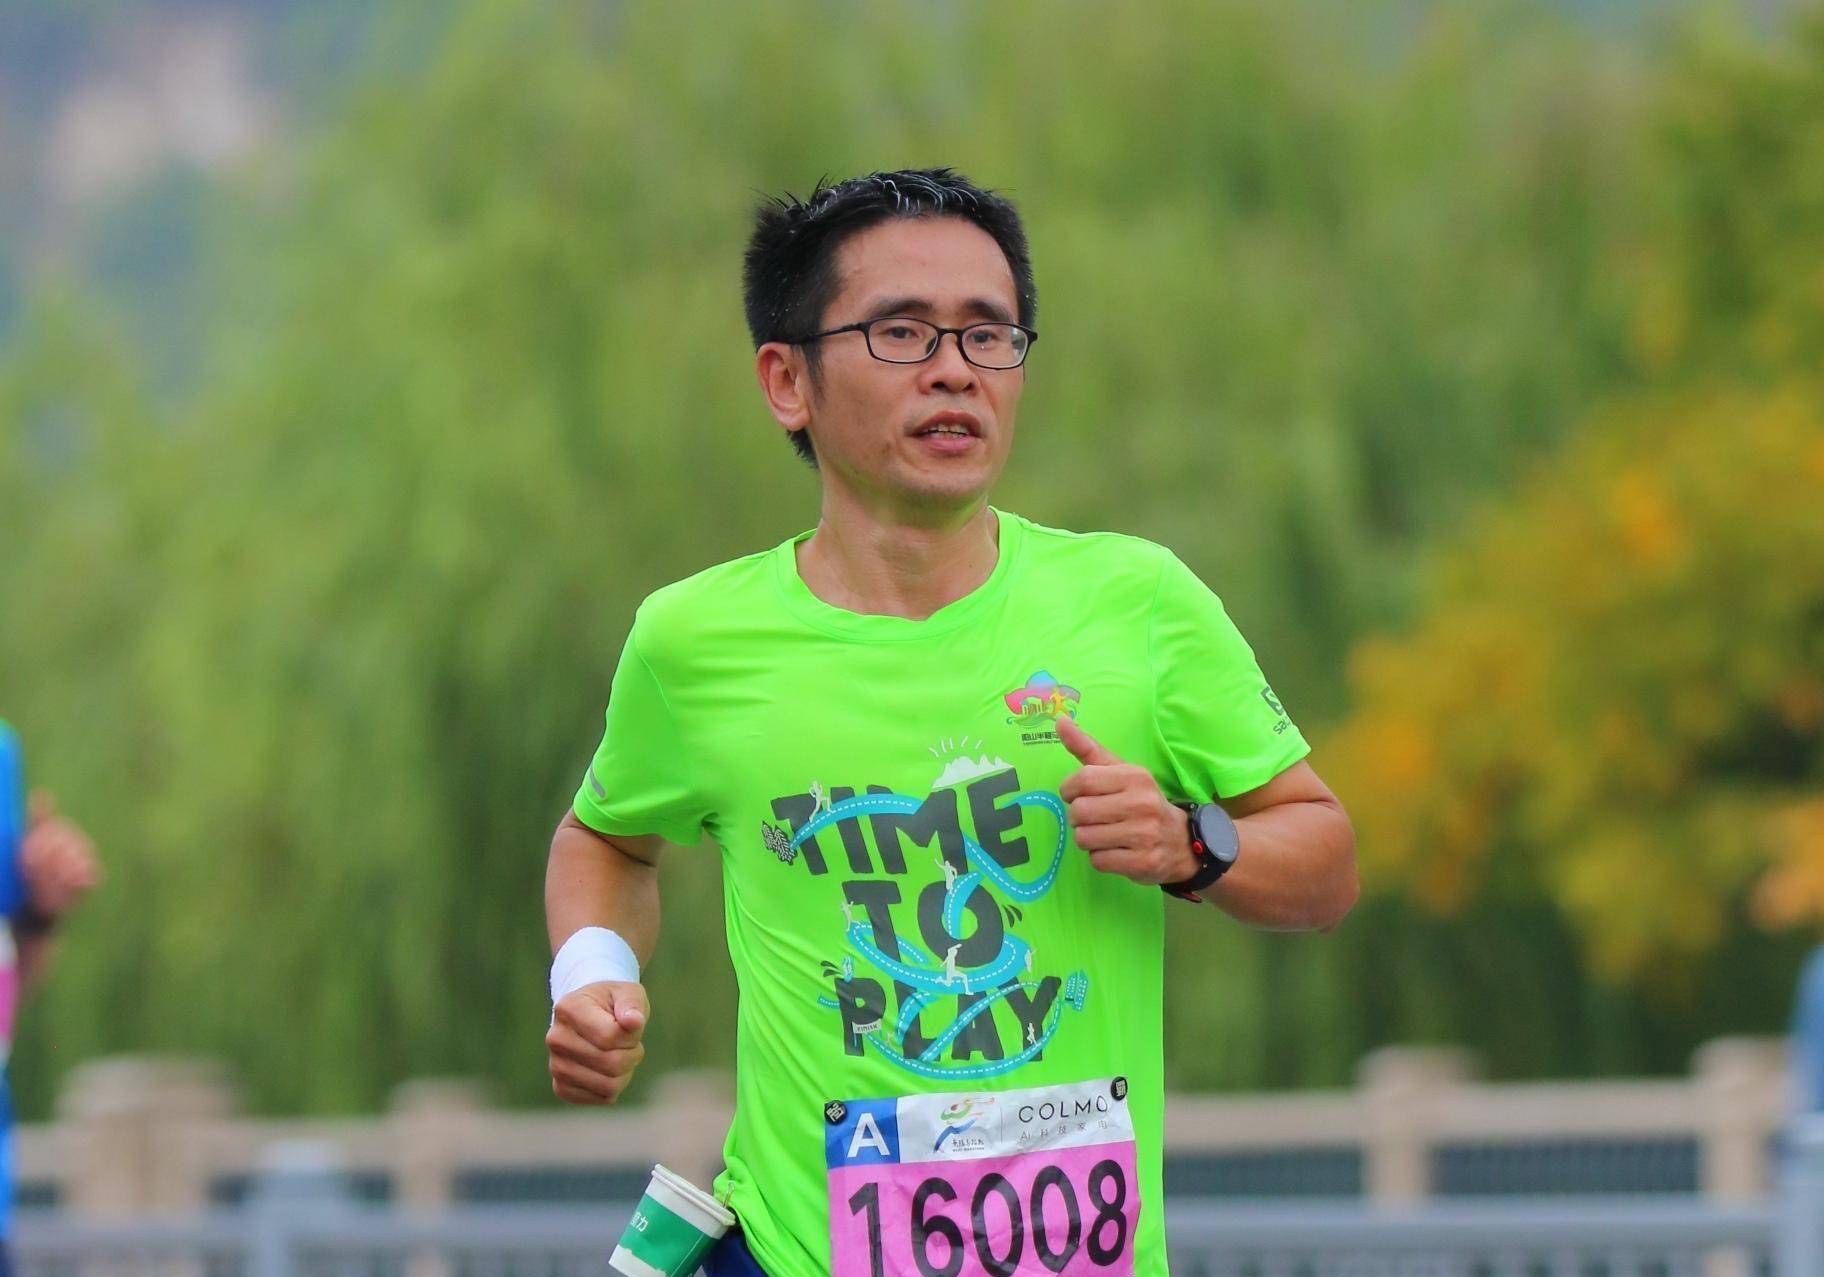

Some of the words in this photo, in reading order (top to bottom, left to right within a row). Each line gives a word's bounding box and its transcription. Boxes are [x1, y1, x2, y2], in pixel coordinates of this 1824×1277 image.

[770, 767, 1030, 875] TIME
[843, 880, 1005, 967] TO
[834, 975, 1062, 1063] PLAY
[847, 1112, 891, 1158] A
[1018, 1095, 1108, 1123] COLMO
